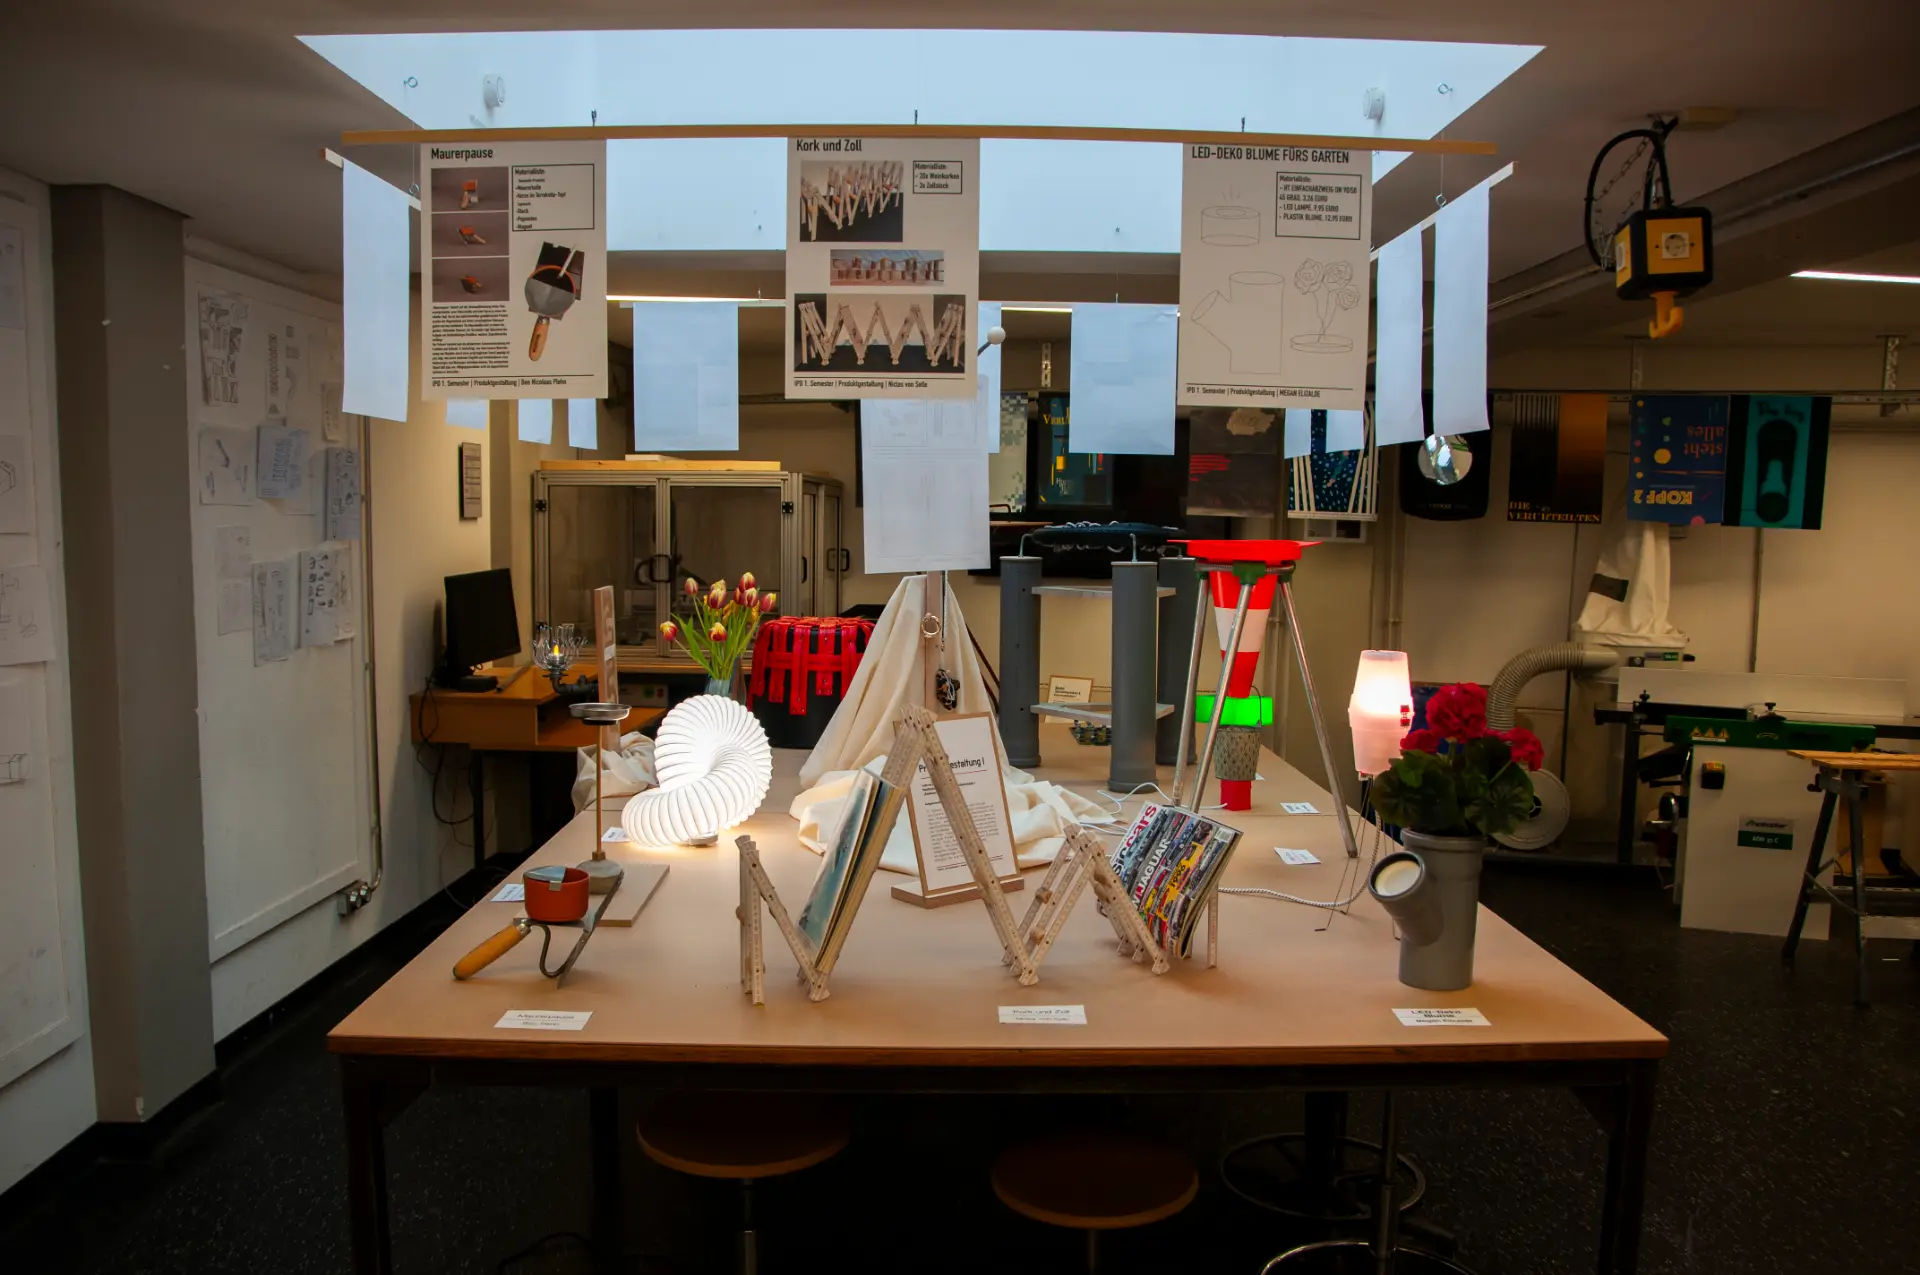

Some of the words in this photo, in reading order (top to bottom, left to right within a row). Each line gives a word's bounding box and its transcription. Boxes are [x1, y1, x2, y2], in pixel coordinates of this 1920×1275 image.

[796, 138, 820, 152] Kork
[822, 139, 842, 152] und
[844, 138, 862, 152] Zoll
[431, 147, 494, 162] Maurerpause
[1192, 146, 1242, 160] LED-DEKO
[1246, 147, 1280, 161] BLUME
[1283, 146, 1309, 162] FÜRS
[1311, 149, 1349, 163] GARTEN
[474, 380, 517, 388] Produktgestaltung
[838, 380, 884, 388] Produktgestaltung
[1230, 388, 1275, 397] Produktgestaltung
[1686, 425, 1725, 440] alles
[1683, 442, 1724, 460] steht
[1633, 489, 1644, 505] 2
[1646, 489, 1693, 505] KOPF
[1509, 500, 1531, 510] DIE
[1508, 511, 1601, 522] VERURTEILTEN
[1138, 838, 1172, 894] JAGUAR
